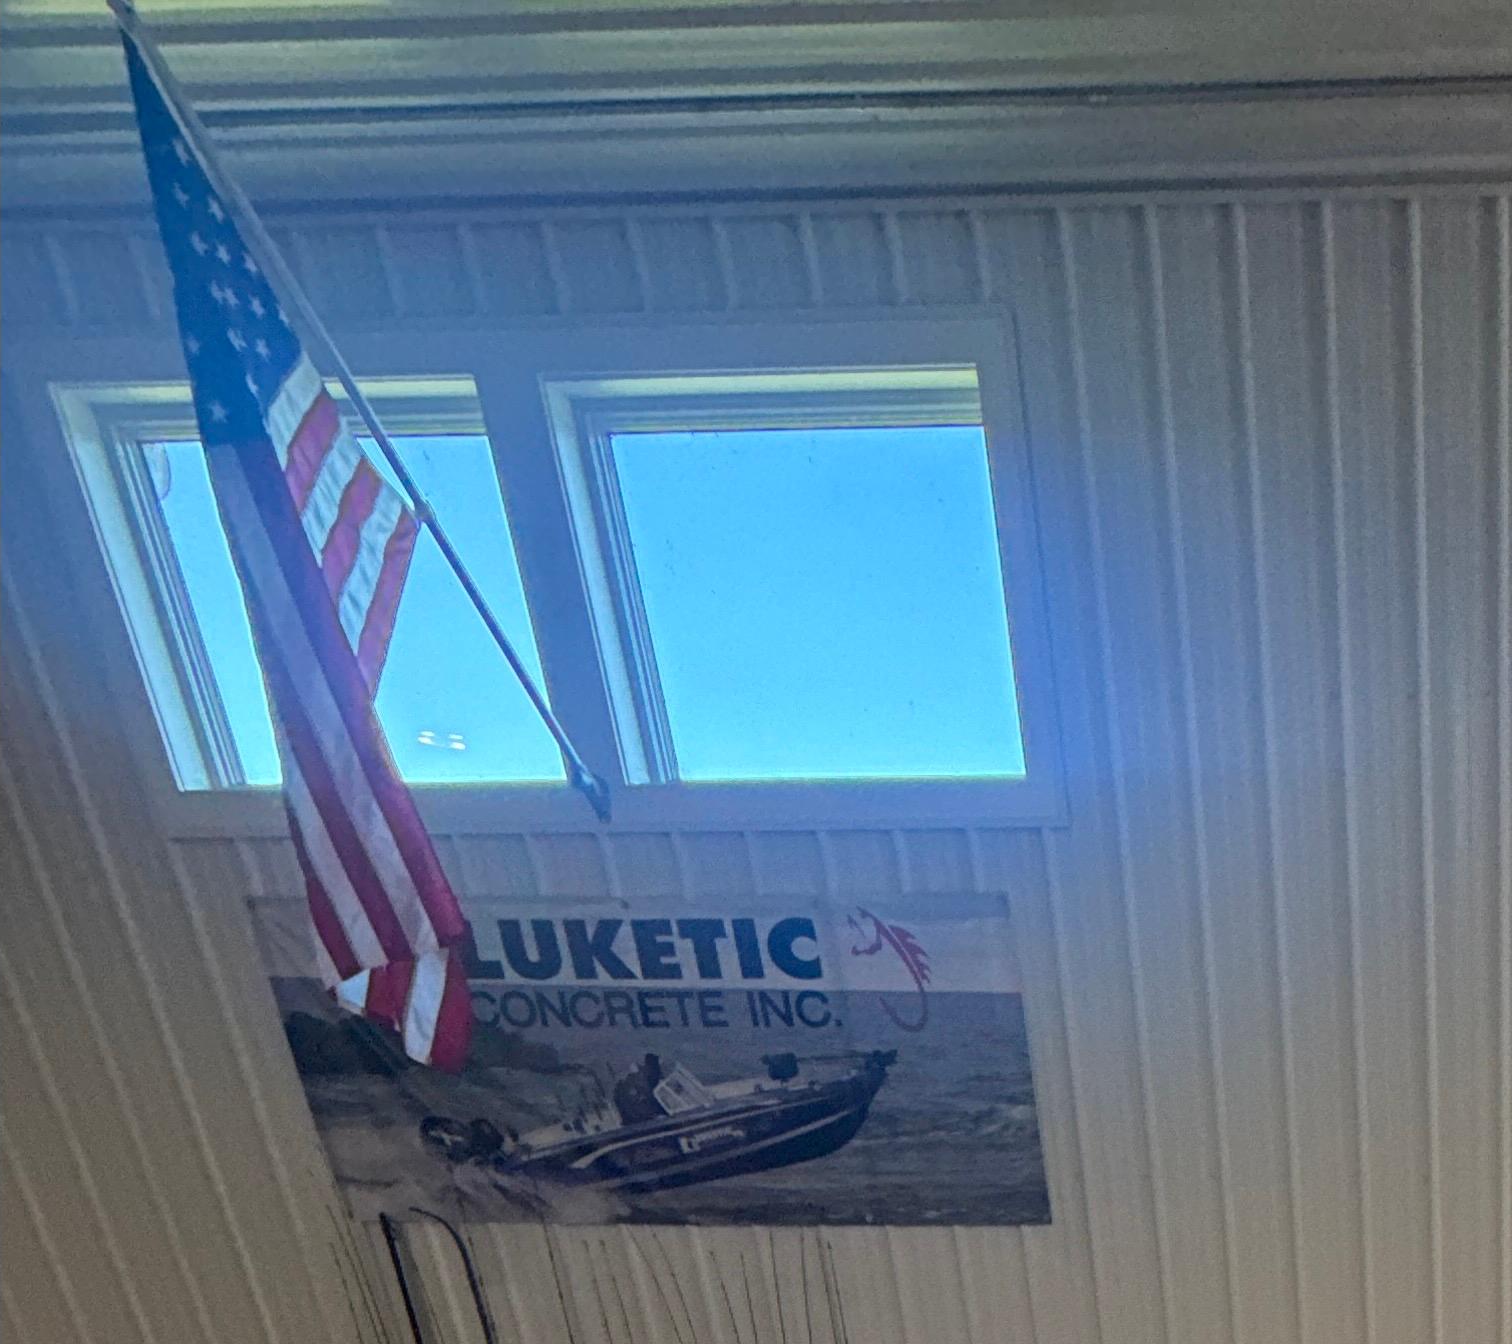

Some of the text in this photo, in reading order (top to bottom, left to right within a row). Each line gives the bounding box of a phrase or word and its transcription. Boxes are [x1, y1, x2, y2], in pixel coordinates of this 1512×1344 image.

[463, 917, 823, 981] LUKETIC
[469, 989, 843, 1029] CONCRETE INC.
